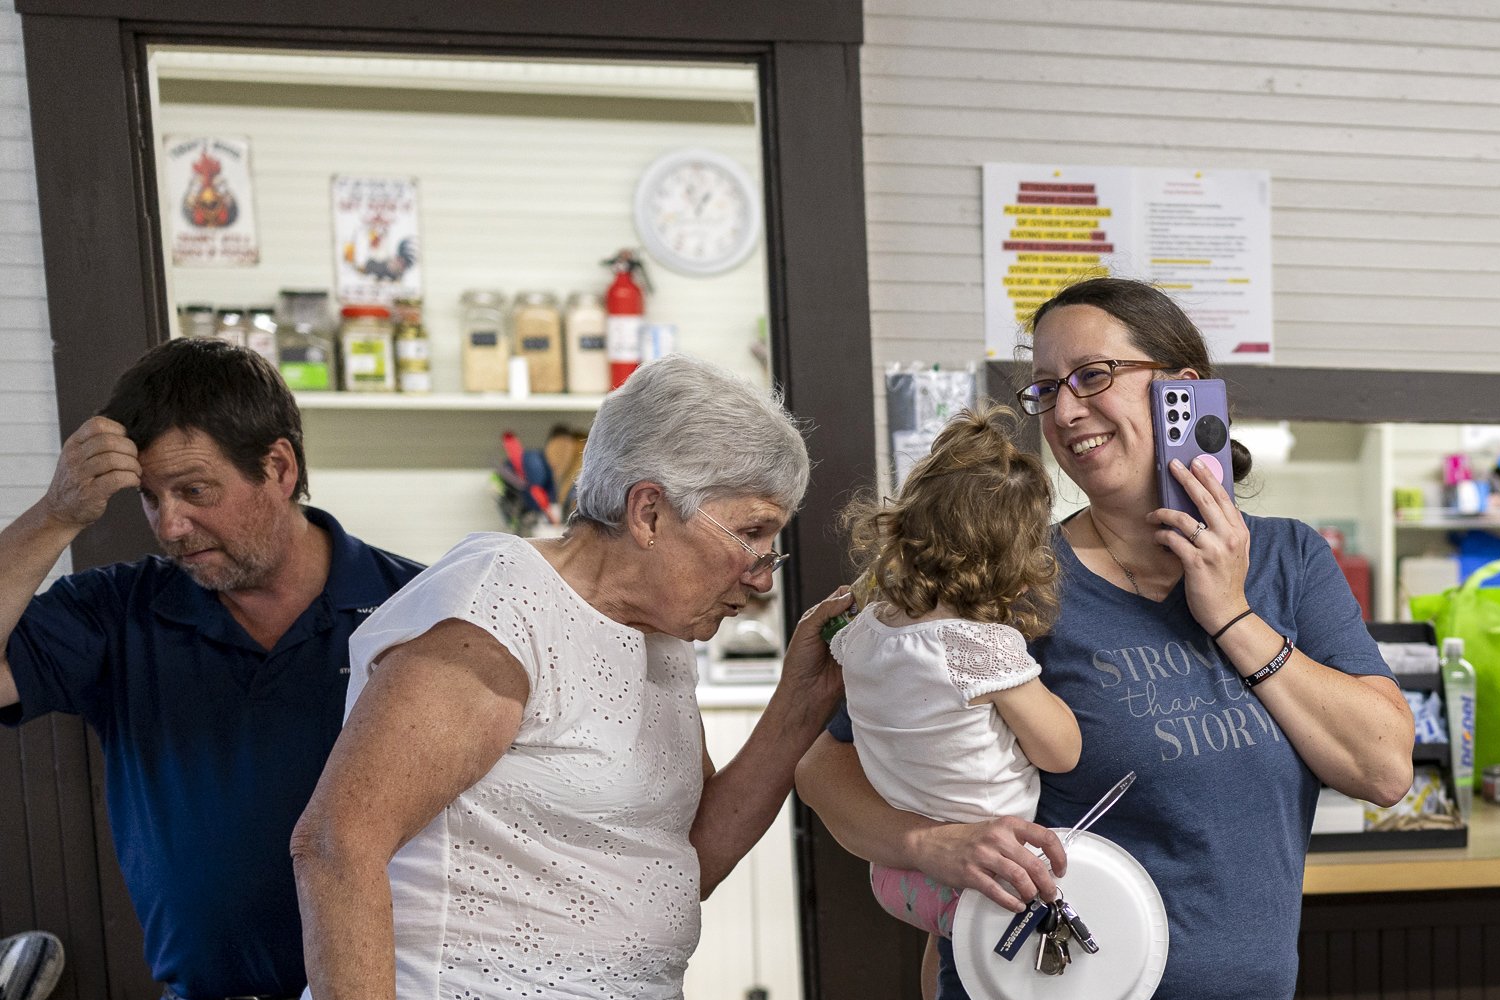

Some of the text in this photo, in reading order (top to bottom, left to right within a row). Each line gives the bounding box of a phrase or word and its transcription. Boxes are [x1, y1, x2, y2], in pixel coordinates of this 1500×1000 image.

[1092, 641, 1226, 689] STRON
[1253, 646, 1290, 680] CHARLIE KIRK
[1119, 681, 1217, 718] than
